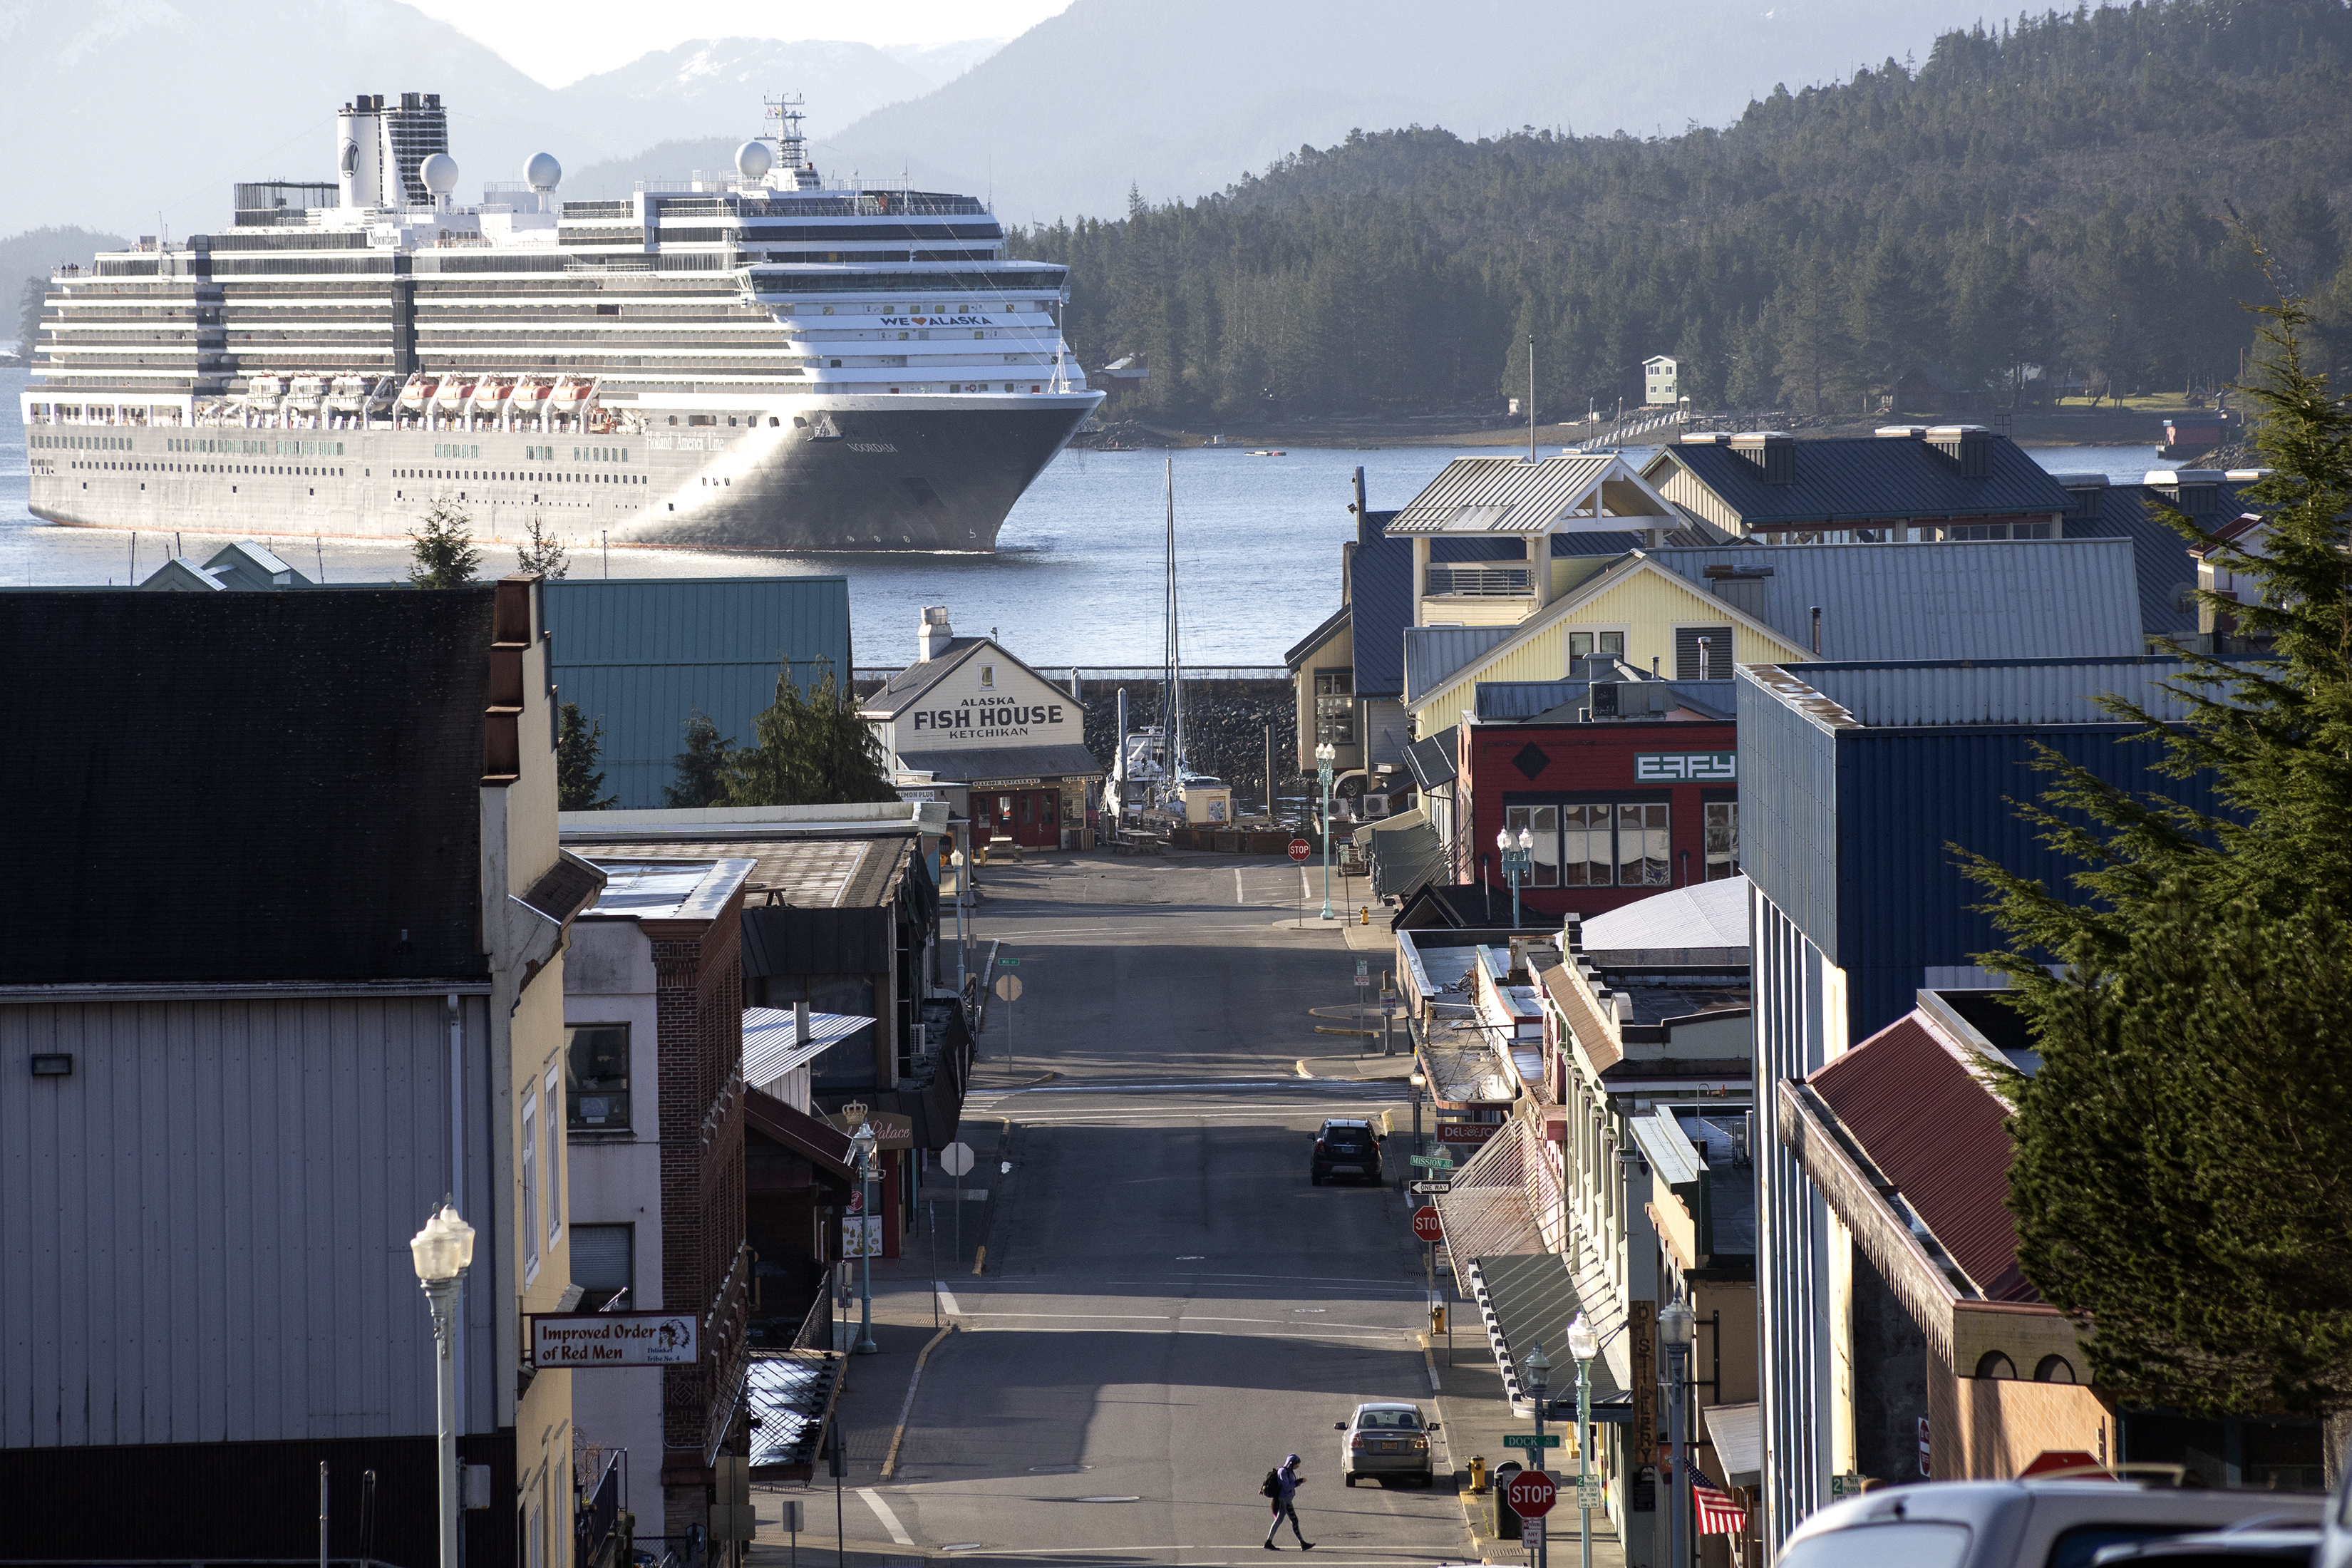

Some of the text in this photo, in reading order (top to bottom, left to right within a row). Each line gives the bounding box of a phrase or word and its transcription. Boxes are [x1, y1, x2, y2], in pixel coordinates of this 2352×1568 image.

[370, 230, 398, 245] Noordam
[880, 316, 993, 326] WE ALASKA
[646, 430, 724, 451] Holland America Line
[846, 443, 898, 452] NOORDAM
[960, 696, 1016, 707] ALASKA
[914, 705, 1064, 730] FISH HOUSE
[949, 728, 1028, 739] KETCHIKAN
[1290, 845, 1309, 854] STOP
[867, 1120, 910, 1140] Palace
[1445, 1127, 1465, 1137] DEL
[1412, 1157, 1443, 1167] MISSION
[542, 1324, 656, 1343] Improved Order
[542, 1345, 623, 1360] of Red Men
[1638, 1306, 1651, 1463] DISTILLERY
[1509, 1436, 1538, 1446] DOCK
[1578, 1476, 1583, 1486] 2
[1834, 1478, 1841, 1492] 2
[1512, 1485, 1553, 1503] STOP
